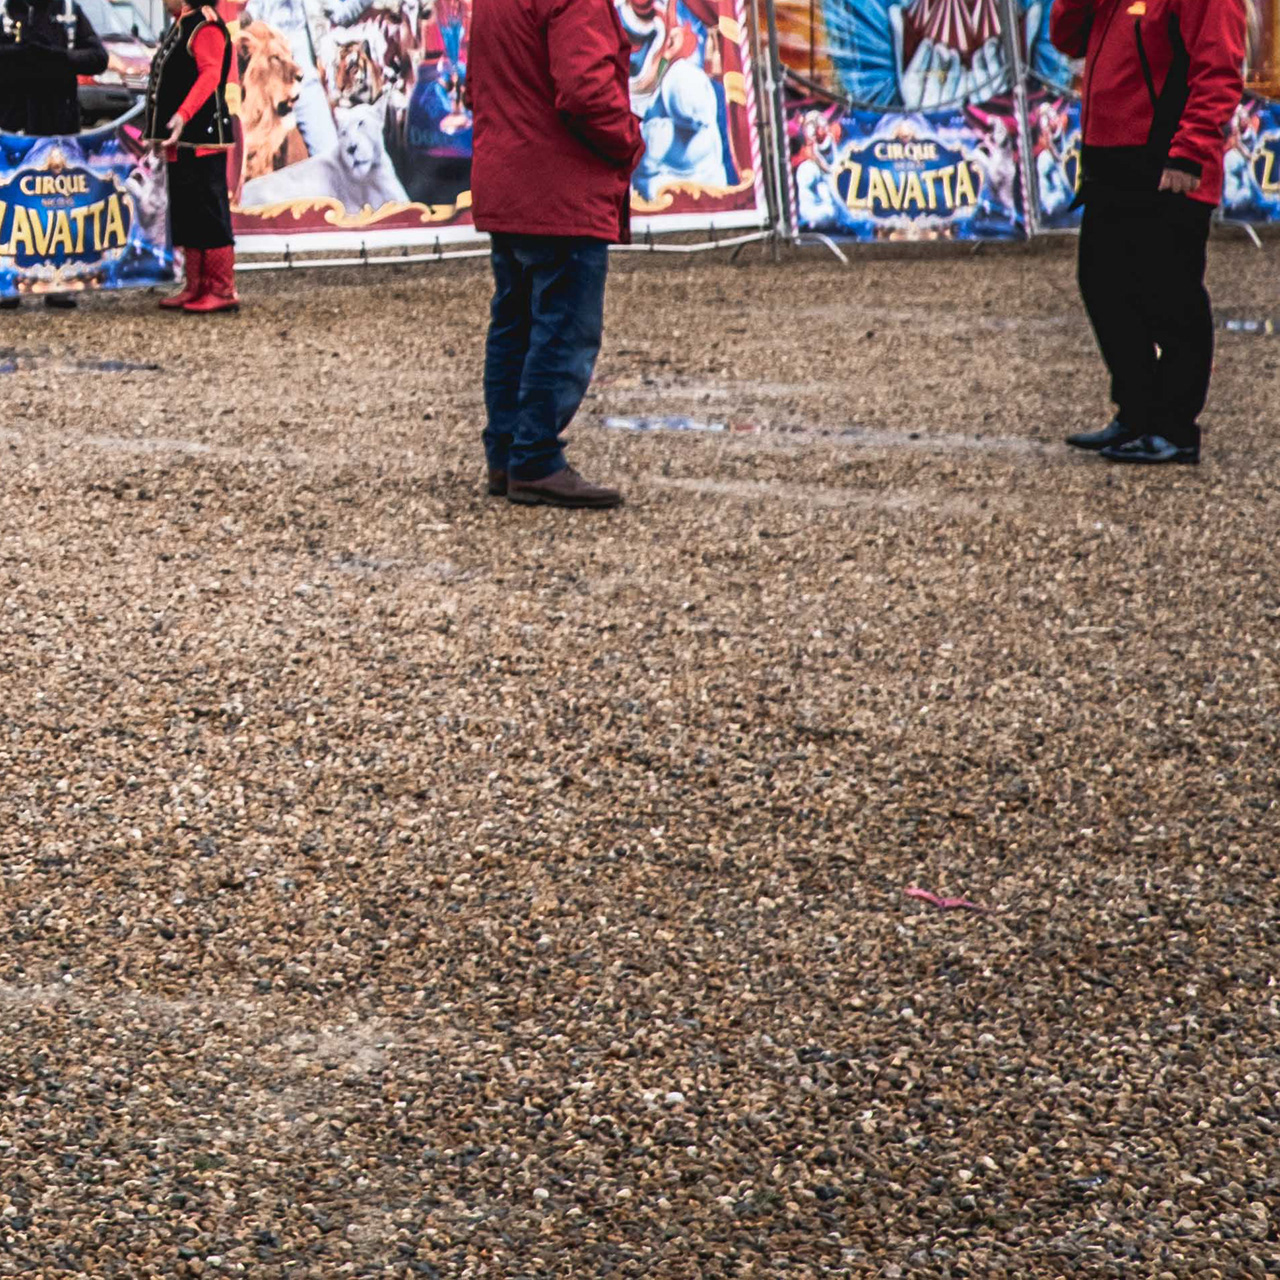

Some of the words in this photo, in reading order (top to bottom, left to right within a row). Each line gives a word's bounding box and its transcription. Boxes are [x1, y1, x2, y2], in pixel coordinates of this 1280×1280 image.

[874, 142, 939, 166] CIRQUE
[19, 172, 89, 197] CIRQUE
[844, 159, 977, 210] ZAVATTA
